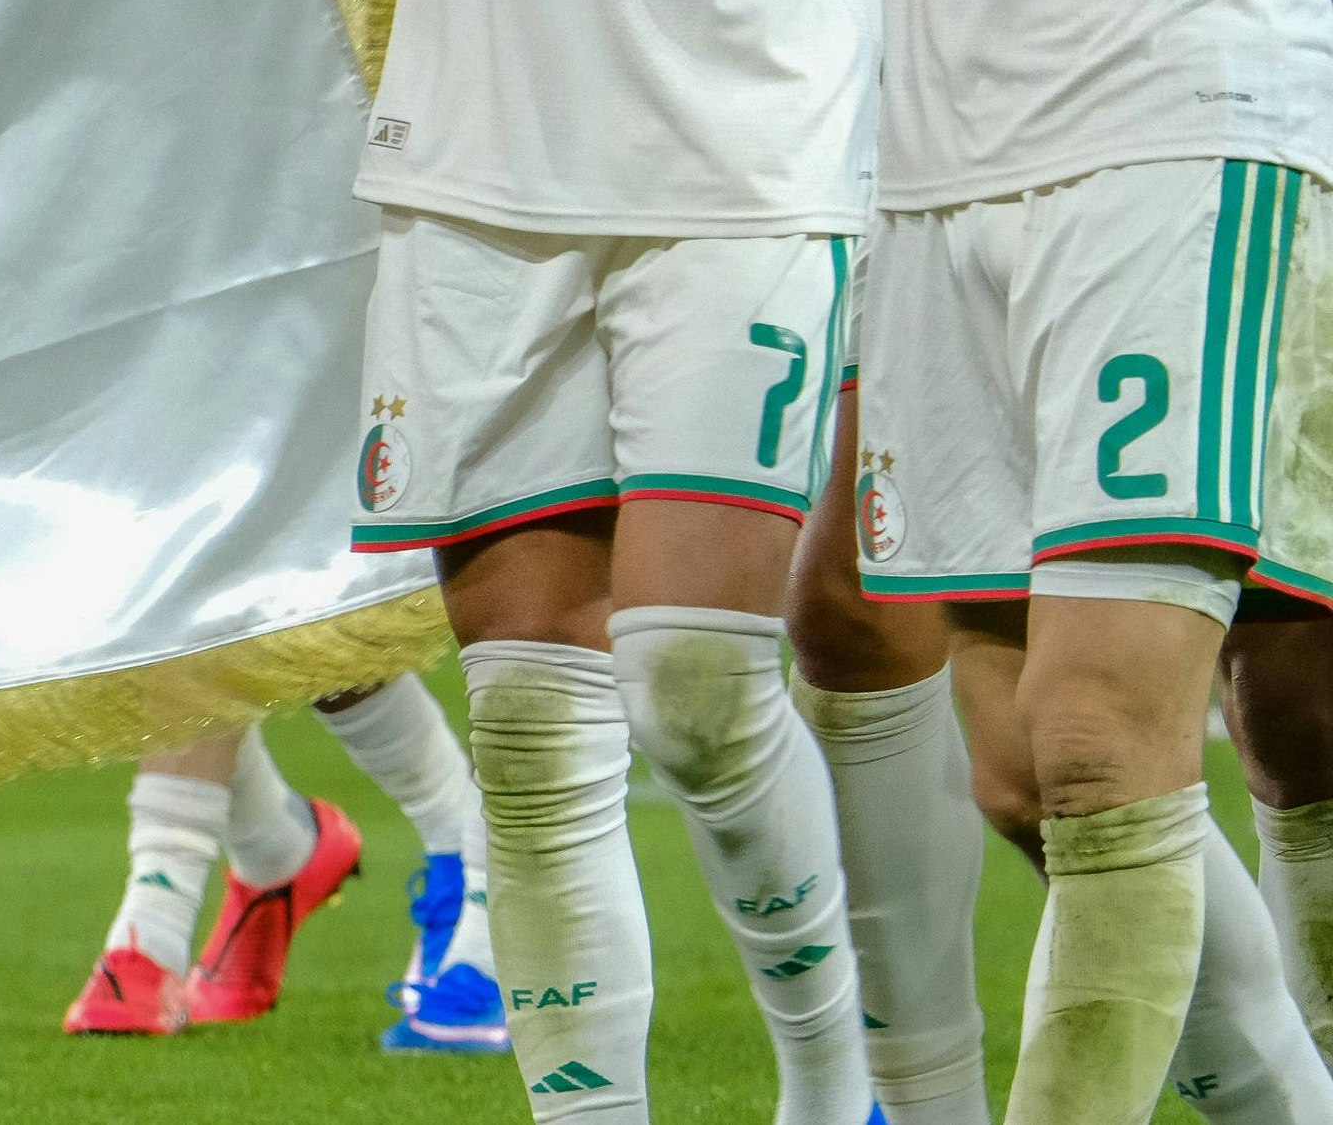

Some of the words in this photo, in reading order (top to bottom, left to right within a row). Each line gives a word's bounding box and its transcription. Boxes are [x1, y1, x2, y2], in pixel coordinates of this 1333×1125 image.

[747, 321, 807, 469] 7
[1095, 352, 1170, 501] 2
[736, 874, 818, 916] FAF
[511, 981, 598, 1011] FAF
[1175, 1074, 1218, 1100] AF
